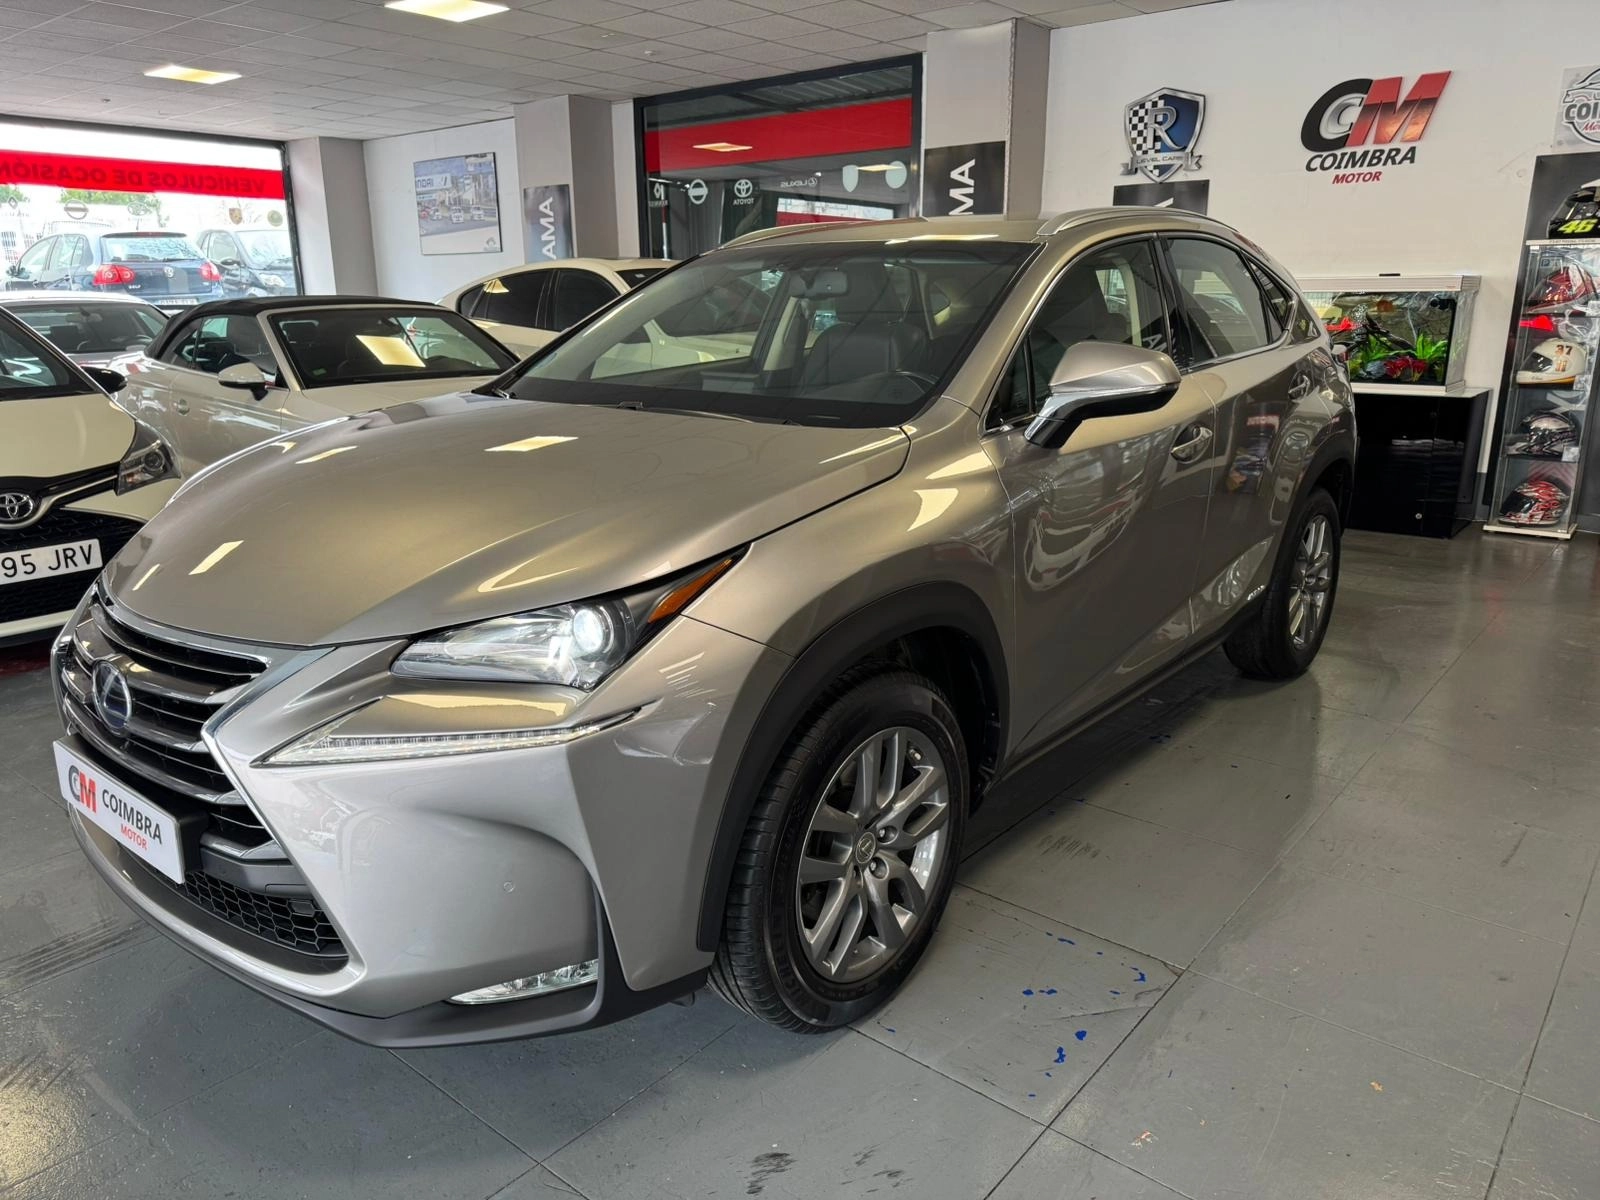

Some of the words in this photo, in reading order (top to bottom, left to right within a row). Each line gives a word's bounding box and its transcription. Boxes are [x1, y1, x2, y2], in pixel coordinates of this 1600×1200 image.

[1565, 101, 1600, 121] COI
[1305, 146, 1417, 172] COIMBRA
[1332, 171, 1383, 185] MOTOR
[1557, 218, 1598, 234] 46
[1, 553, 37, 578] 95
[48, 543, 93, 571] JRV
[102, 788, 163, 845] COIMBRA
[120, 823, 148, 851] MOTOR
